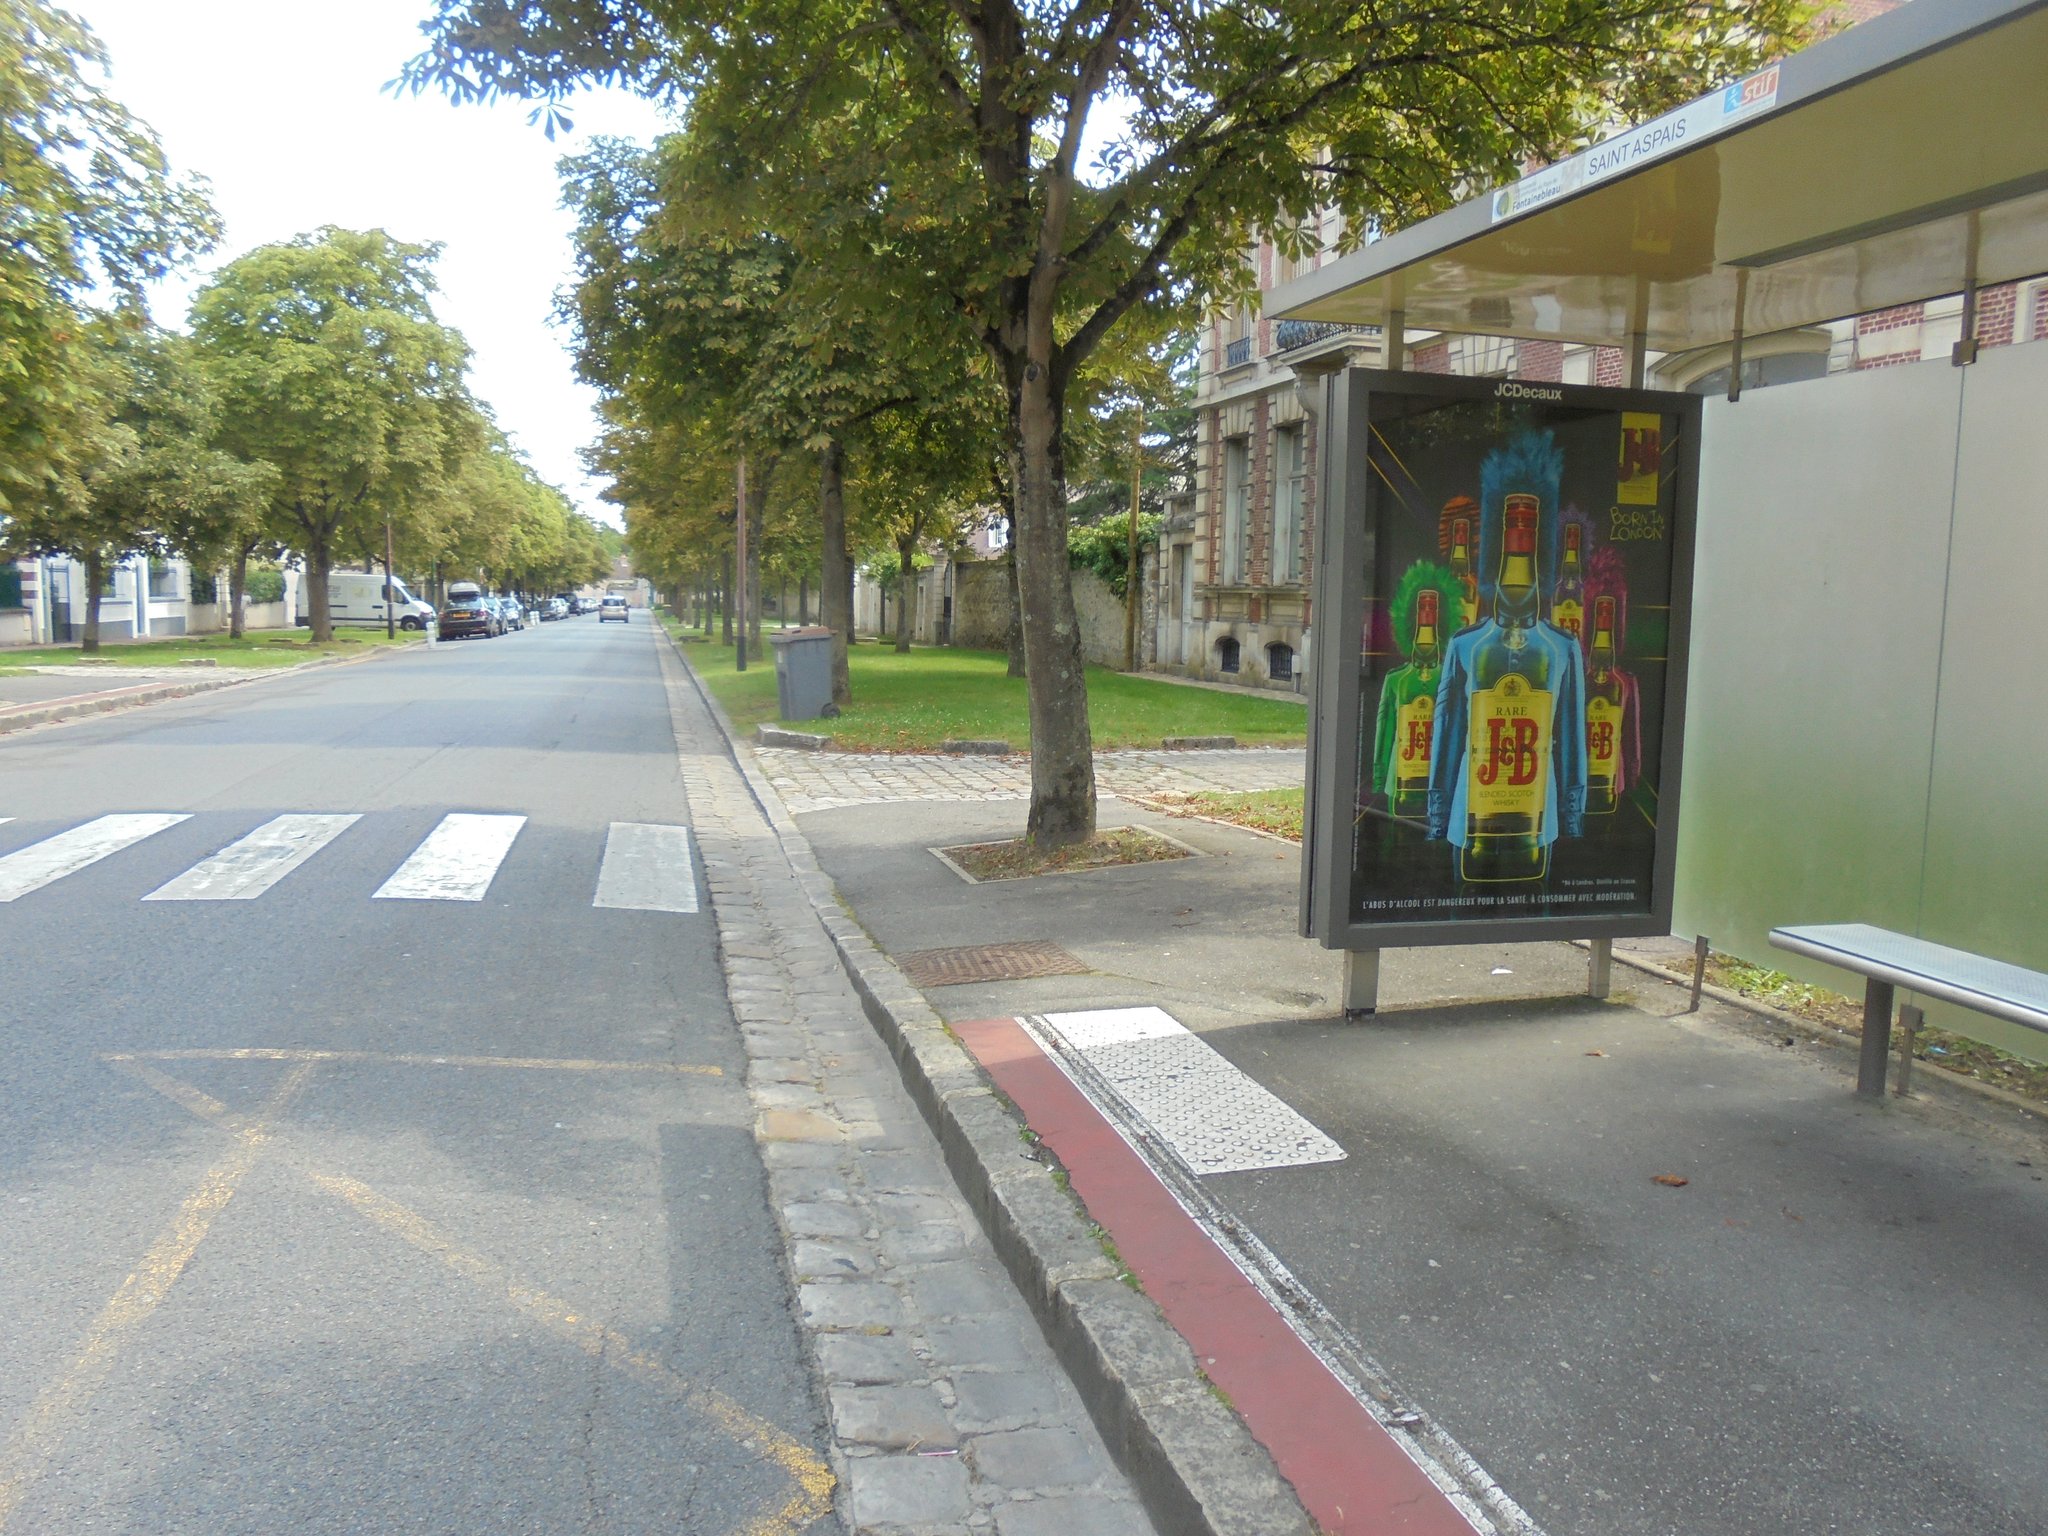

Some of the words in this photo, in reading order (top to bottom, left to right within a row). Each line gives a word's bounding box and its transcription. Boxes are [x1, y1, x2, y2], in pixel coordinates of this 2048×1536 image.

[1741, 70, 1777, 104] stif
[1589, 143, 1630, 176] SAINT
[1631, 118, 1687, 158] ASPAIS
[1512, 186, 1561, 213] Fontainebleau
[1494, 383, 1562, 400] JCDecaux
[1610, 506, 1647, 526] BORN
[1496, 706, 1528, 716] RARE
[1477, 718, 1539, 785] J&B
[1363, 900, 1386, 910] L'ABUS
[1389, 899, 1420, 909] D'ALCOOL
[1423, 898, 1435, 907] EST
[1438, 897, 1474, 907] DANGEREUX
[1477, 896, 1495, 906] POUR
[1497, 896, 1505, 905] LA
[1538, 893, 1576, 903] CONSOMMER
[1578, 892, 1594, 902] AVEC
